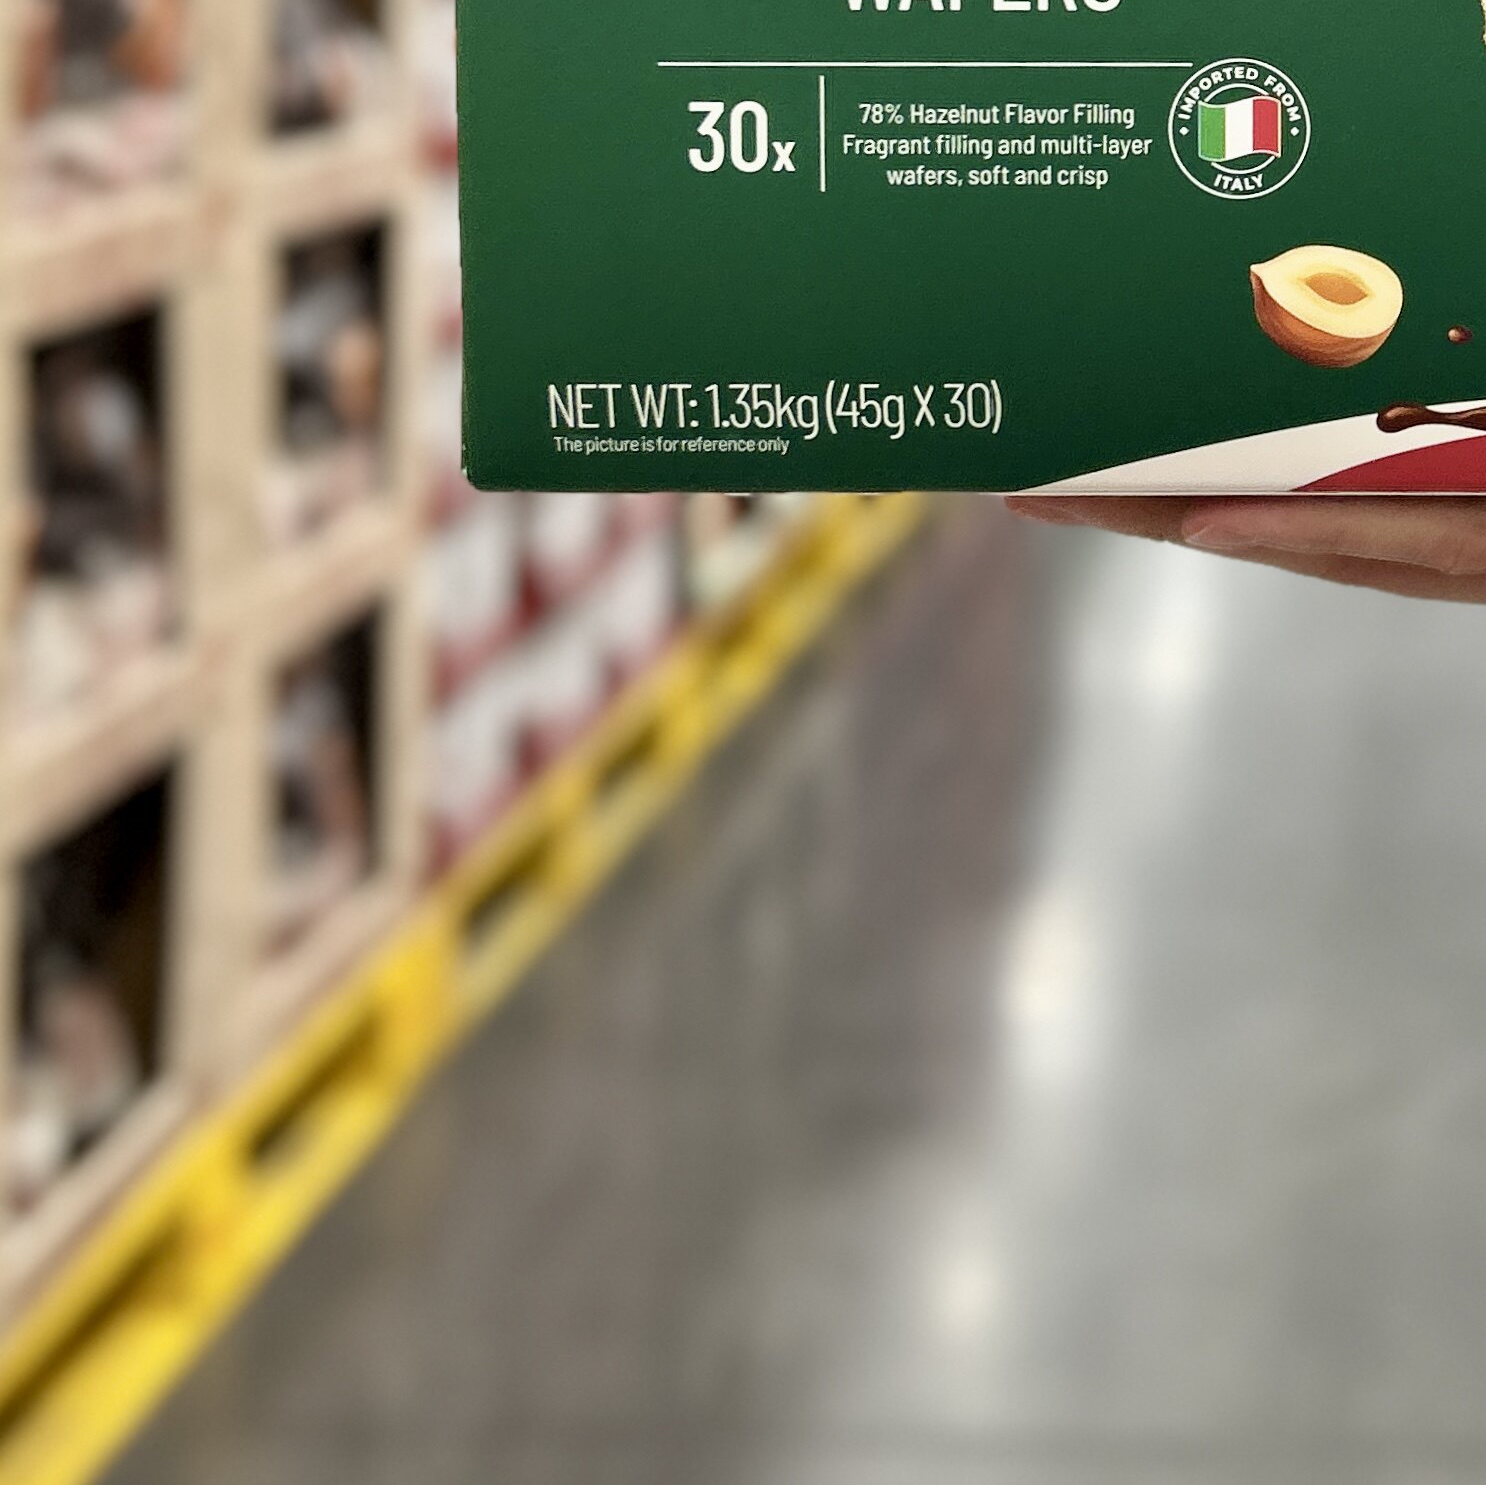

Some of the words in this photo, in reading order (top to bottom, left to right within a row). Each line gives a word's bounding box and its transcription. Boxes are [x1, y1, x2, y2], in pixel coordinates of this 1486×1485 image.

[1178, 66, 1259, 120] IMPORTED
[1263, 74, 1302, 122] FROM
[858, 103, 904, 124] 78%
[909, 104, 1000, 125] Hazelnut
[1005, 104, 1069, 125] Flavor
[1073, 103, 1136, 130] Filling
[686, 100, 797, 174] 30x
[842, 134, 931, 160] Fragrant
[935, 134, 994, 160] filling
[997, 135, 1037, 155] and
[1040, 134, 1153, 160] multi-layer
[886, 165, 963, 188] wafers,
[968, 165, 1010, 186] soft
[1014, 166, 1053, 186] and
[1056, 165, 1109, 190] crisp
[1213, 173, 1264, 192] ITALY
[548, 383, 622, 429] NET
[630, 383, 700, 429] WT:
[943, 380, 1003, 434] 30)
[553, 436, 584, 453] The
[585, 436, 640, 455] picture
[641, 436, 654, 452] is
[654, 436, 680, 452] for
[681, 436, 757, 452] reference
[757, 436, 790, 455] only
